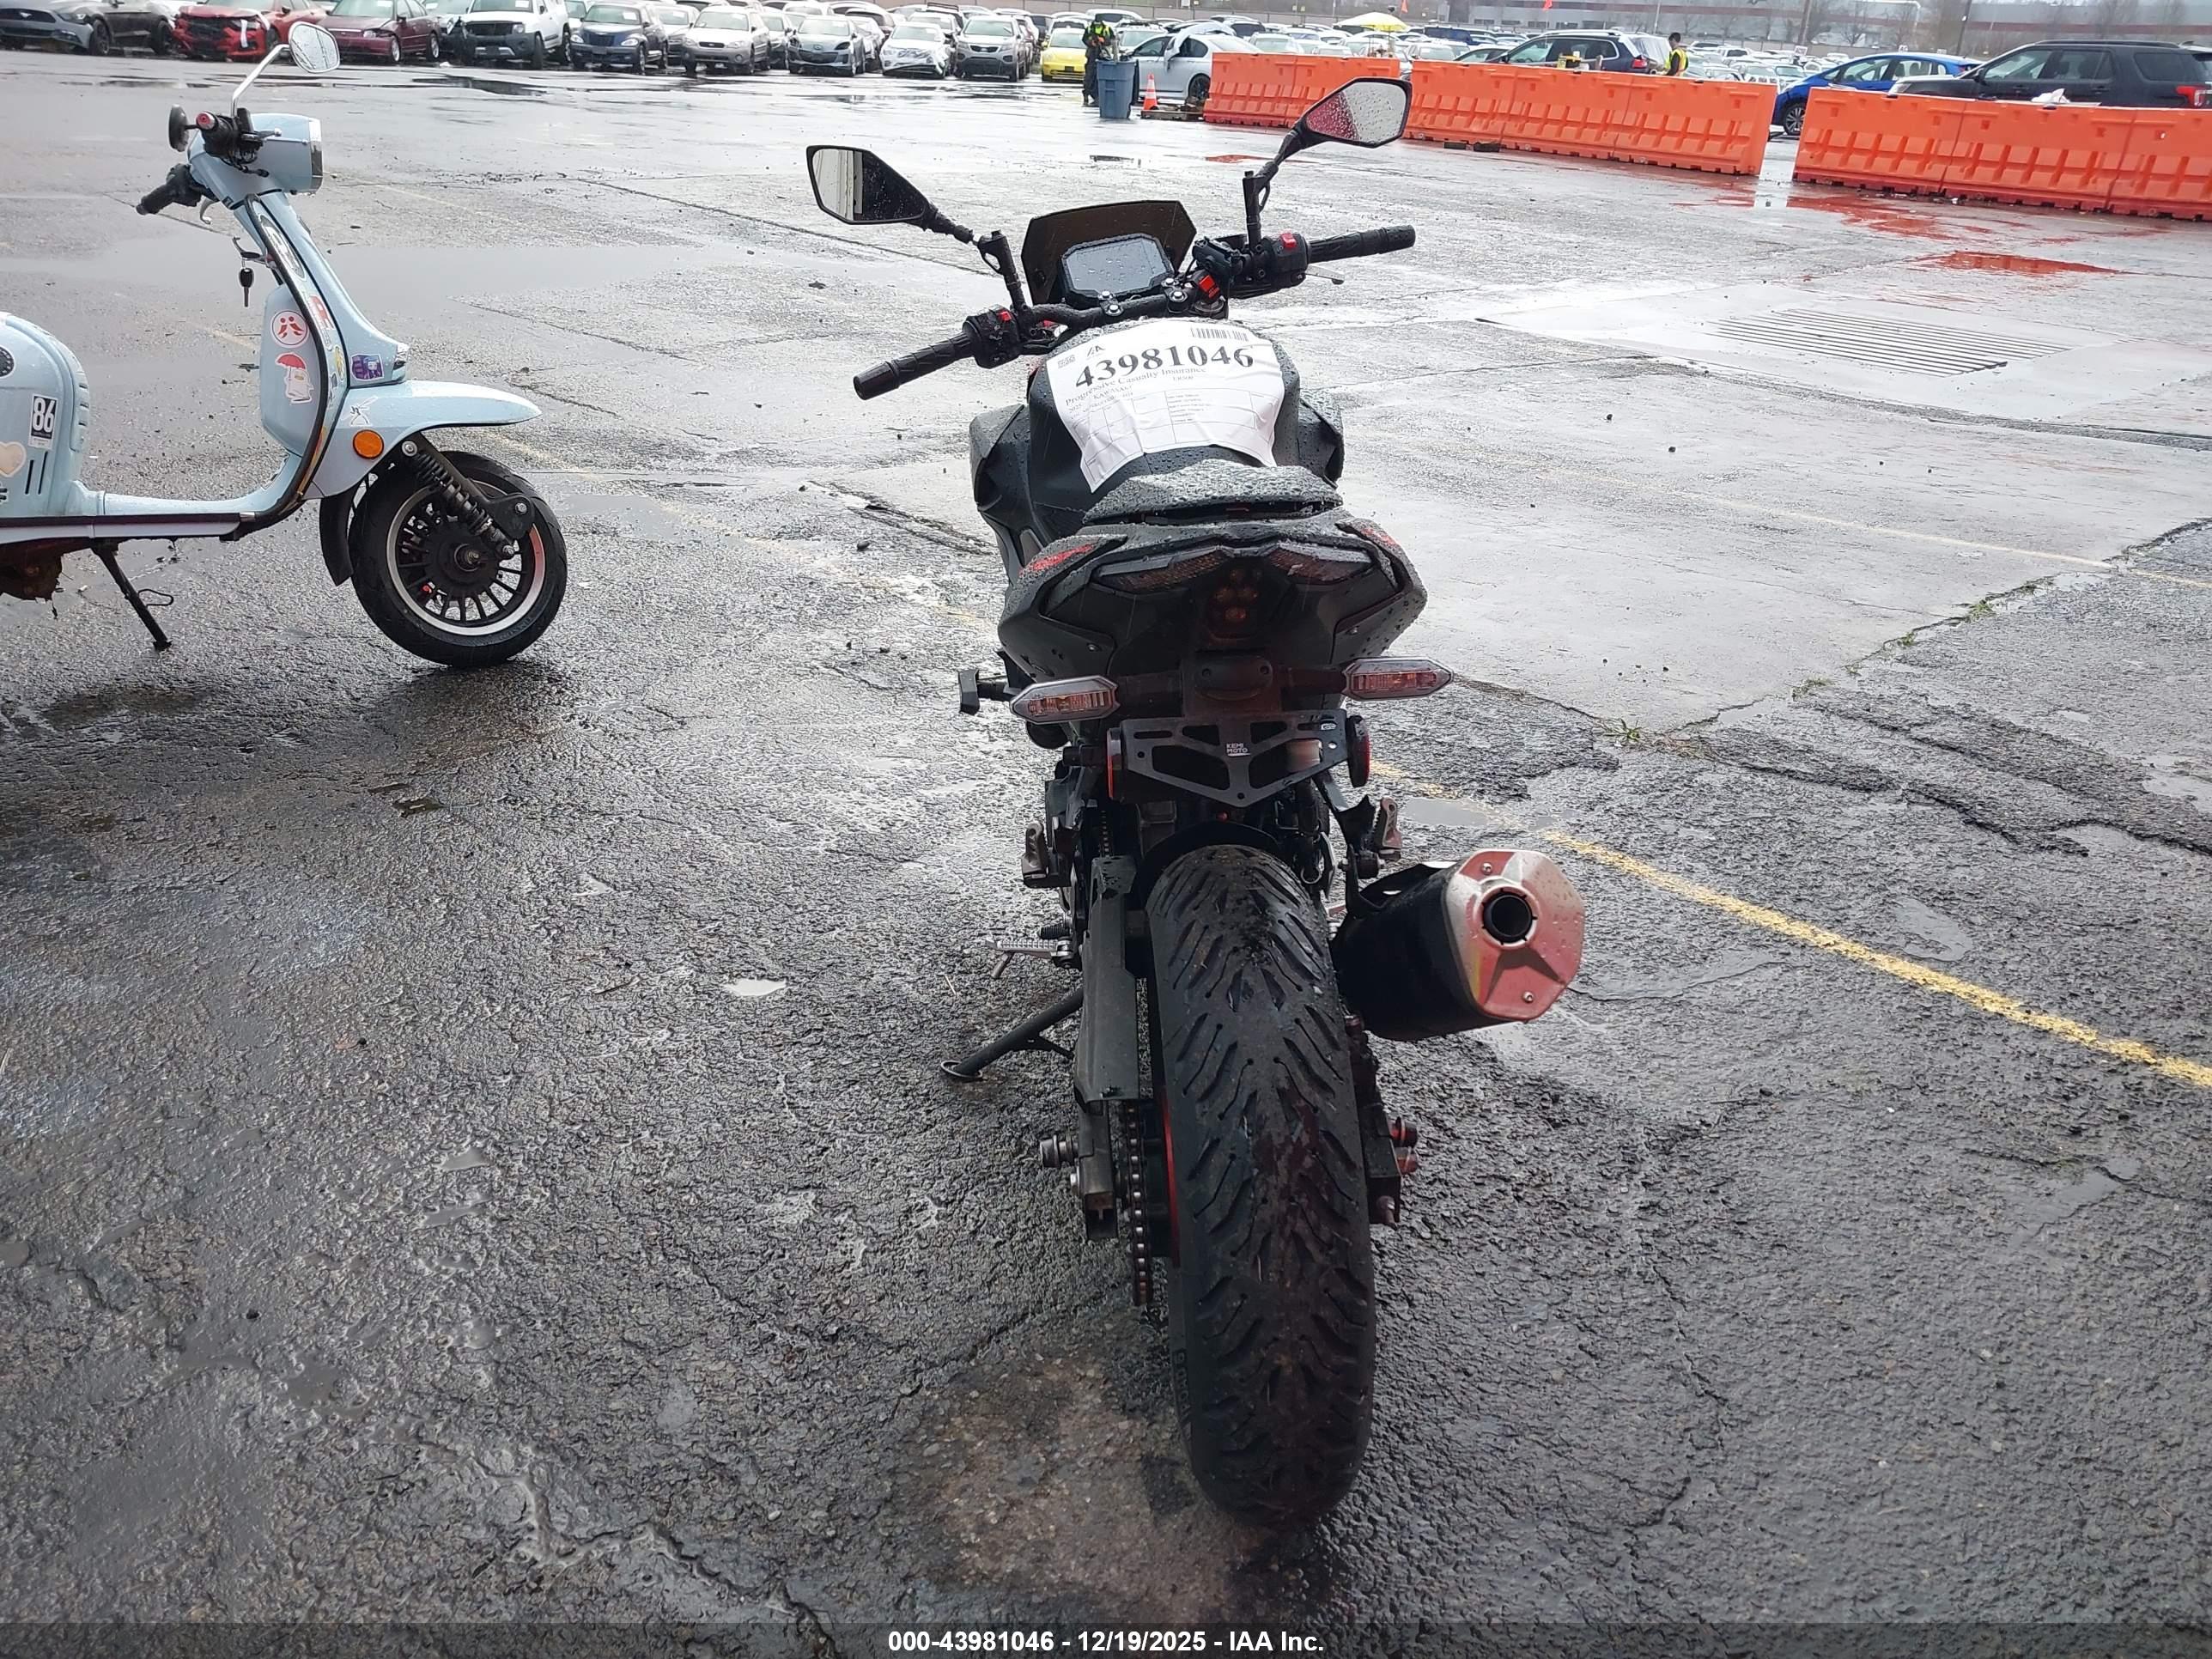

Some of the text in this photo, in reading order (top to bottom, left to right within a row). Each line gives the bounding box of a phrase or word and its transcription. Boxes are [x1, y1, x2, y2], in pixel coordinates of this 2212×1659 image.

[1075, 345, 1254, 387] 43981046
[1066, 367, 1206, 406] Progressive Casualty Insurance
[33, 397, 56, 433] 86
